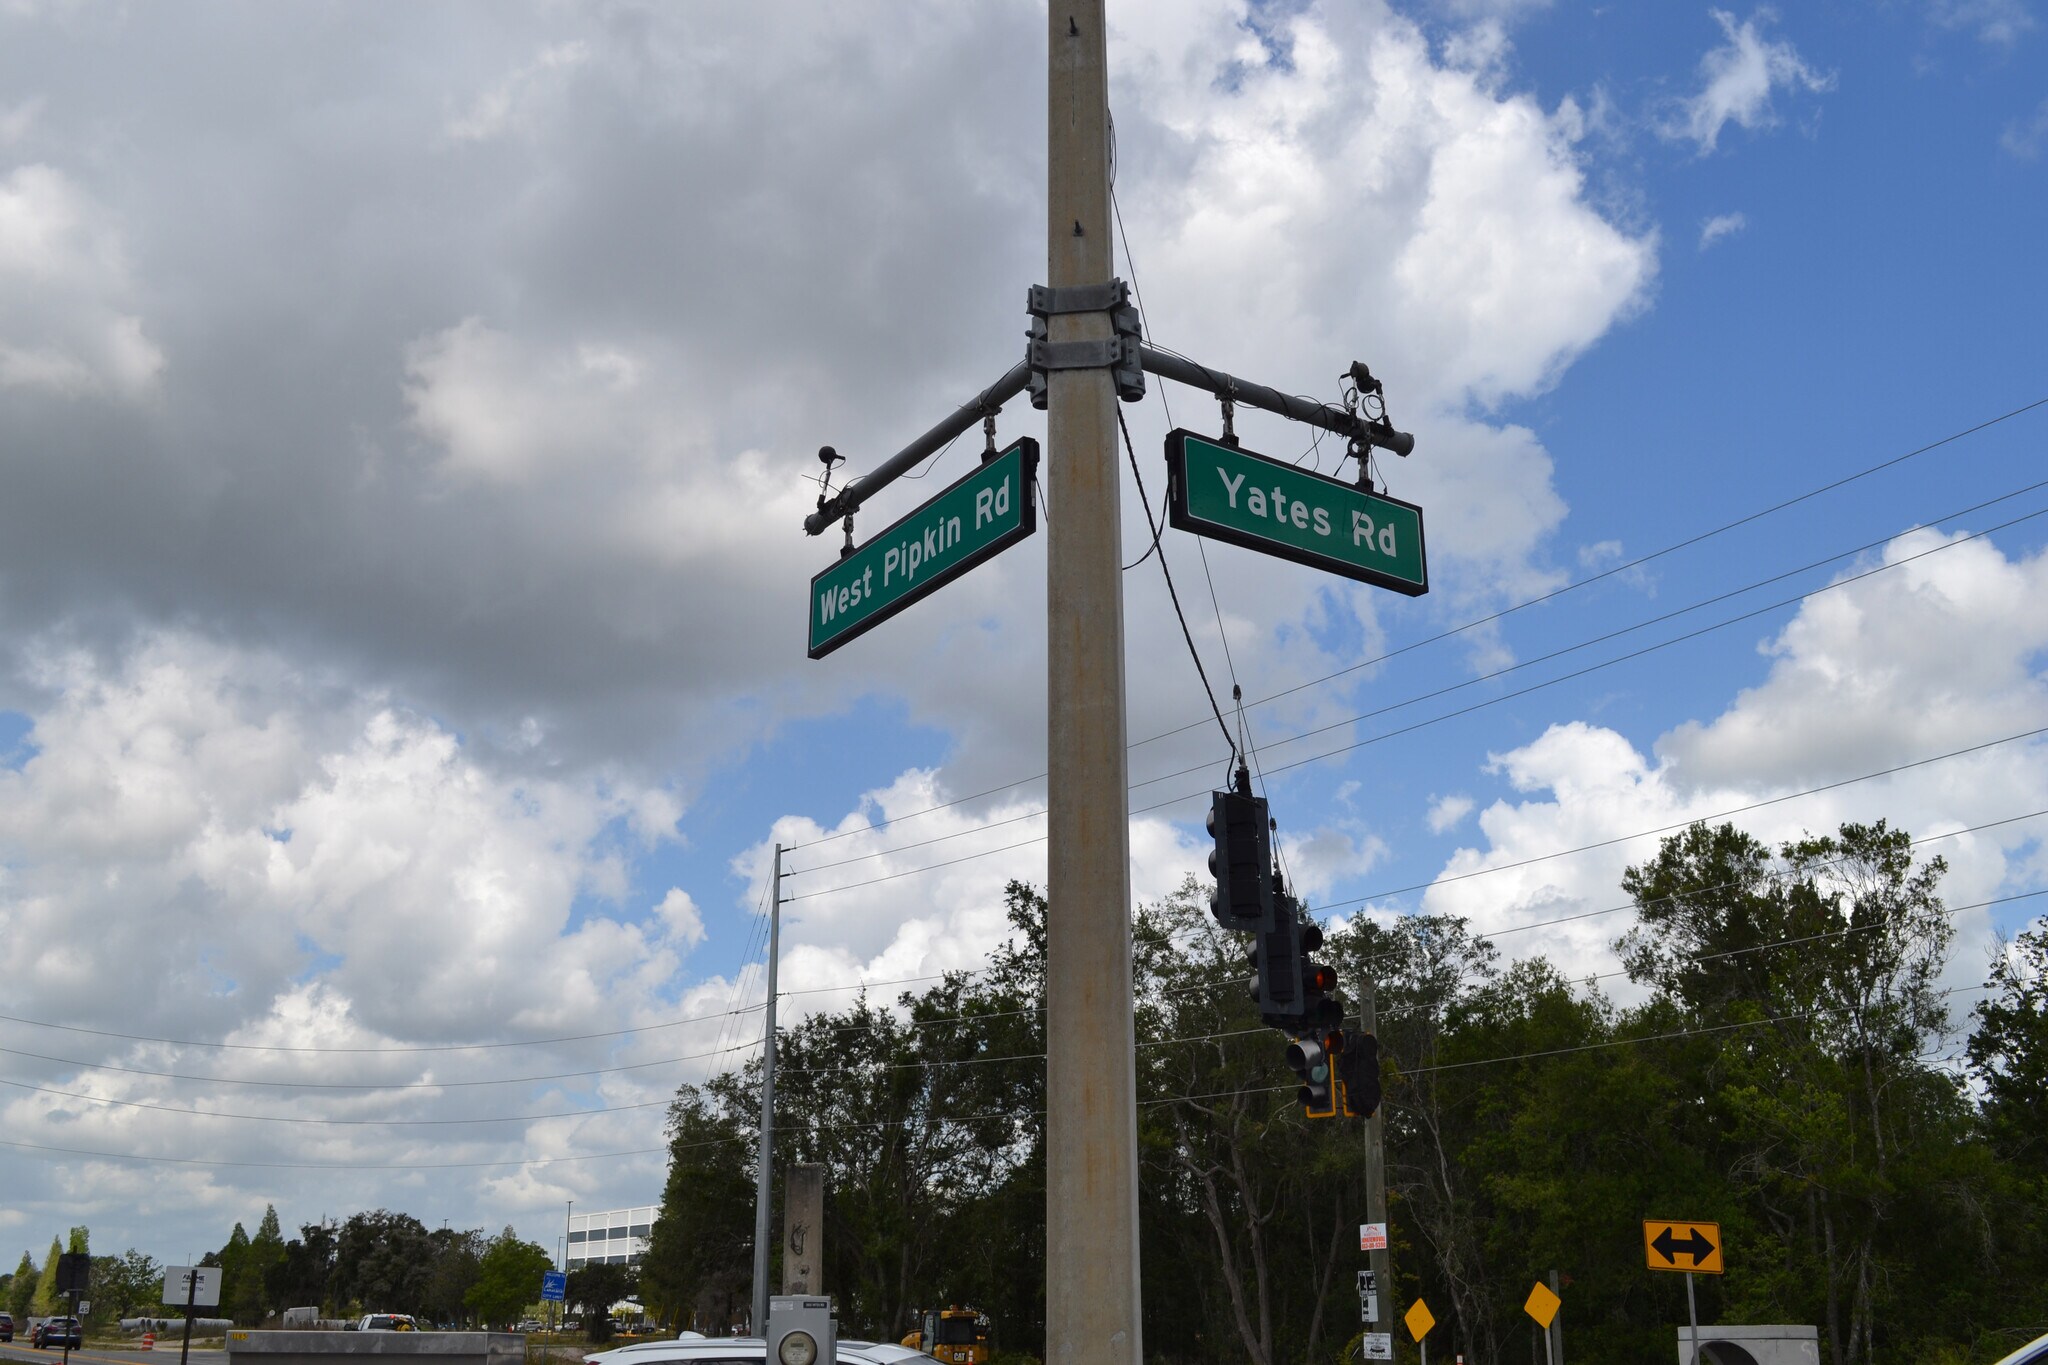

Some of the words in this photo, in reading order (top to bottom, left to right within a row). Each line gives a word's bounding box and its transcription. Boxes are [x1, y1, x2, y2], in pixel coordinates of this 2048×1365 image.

[820, 564, 872, 625] West
[884, 516, 961, 587] Pipkin
[975, 474, 1010, 530] Rd
[1216, 466, 1331, 536] Yates
[1351, 509, 1397, 558] Rd
[953, 1352, 965, 1361] CAT
